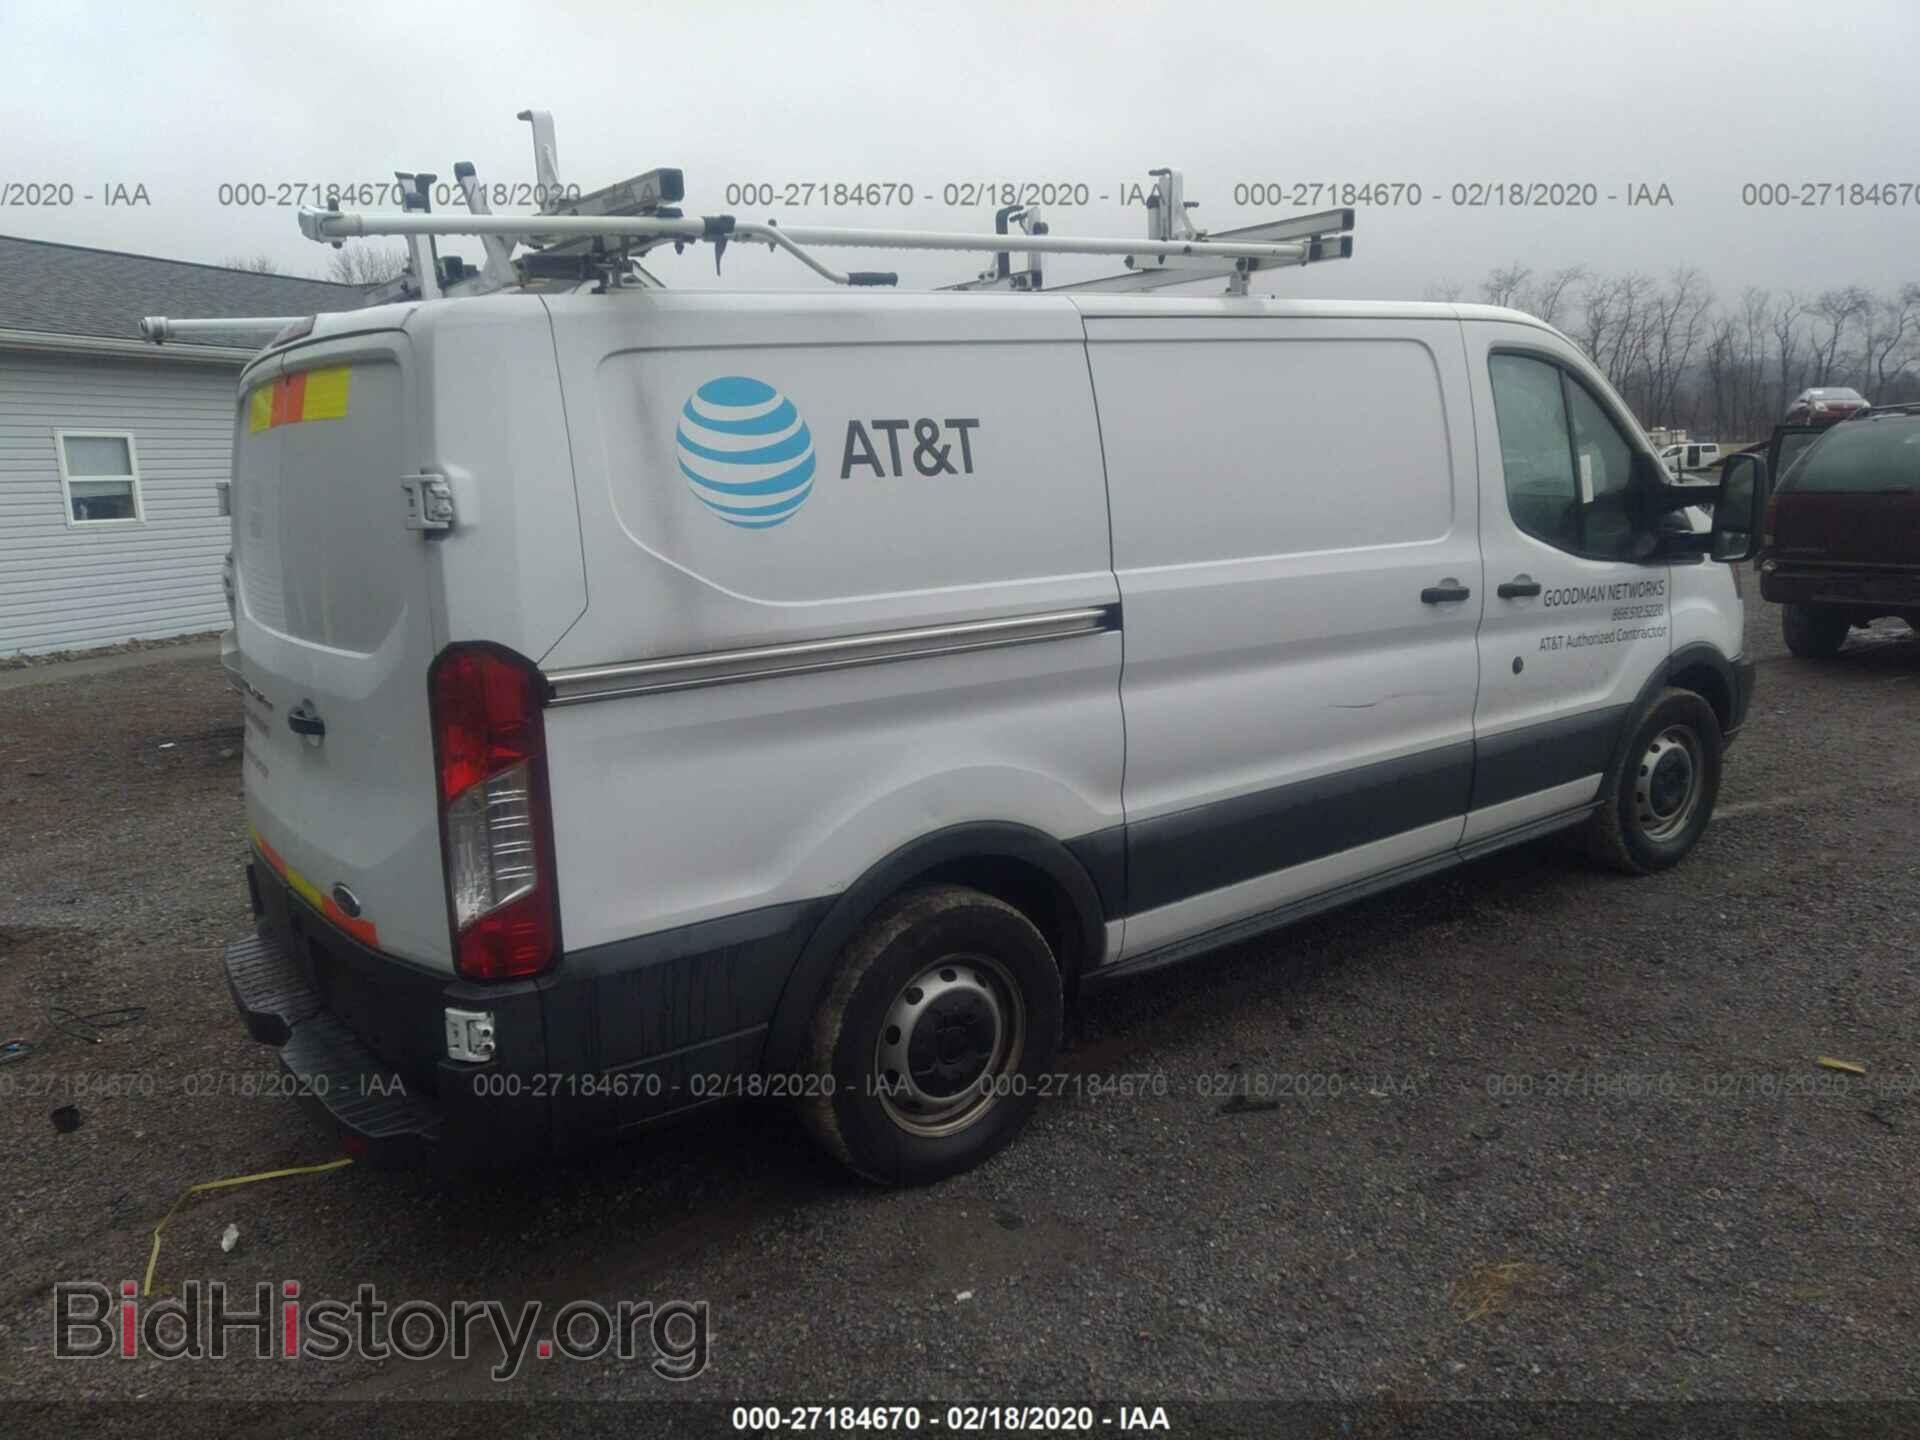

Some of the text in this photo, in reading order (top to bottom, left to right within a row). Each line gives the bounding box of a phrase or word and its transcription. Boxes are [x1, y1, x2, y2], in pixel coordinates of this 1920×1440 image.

[840, 417, 981, 480] AT&T
[1544, 580, 1664, 607] GOODMAN NETWORKS
[1539, 635, 1566, 651] AT&T
